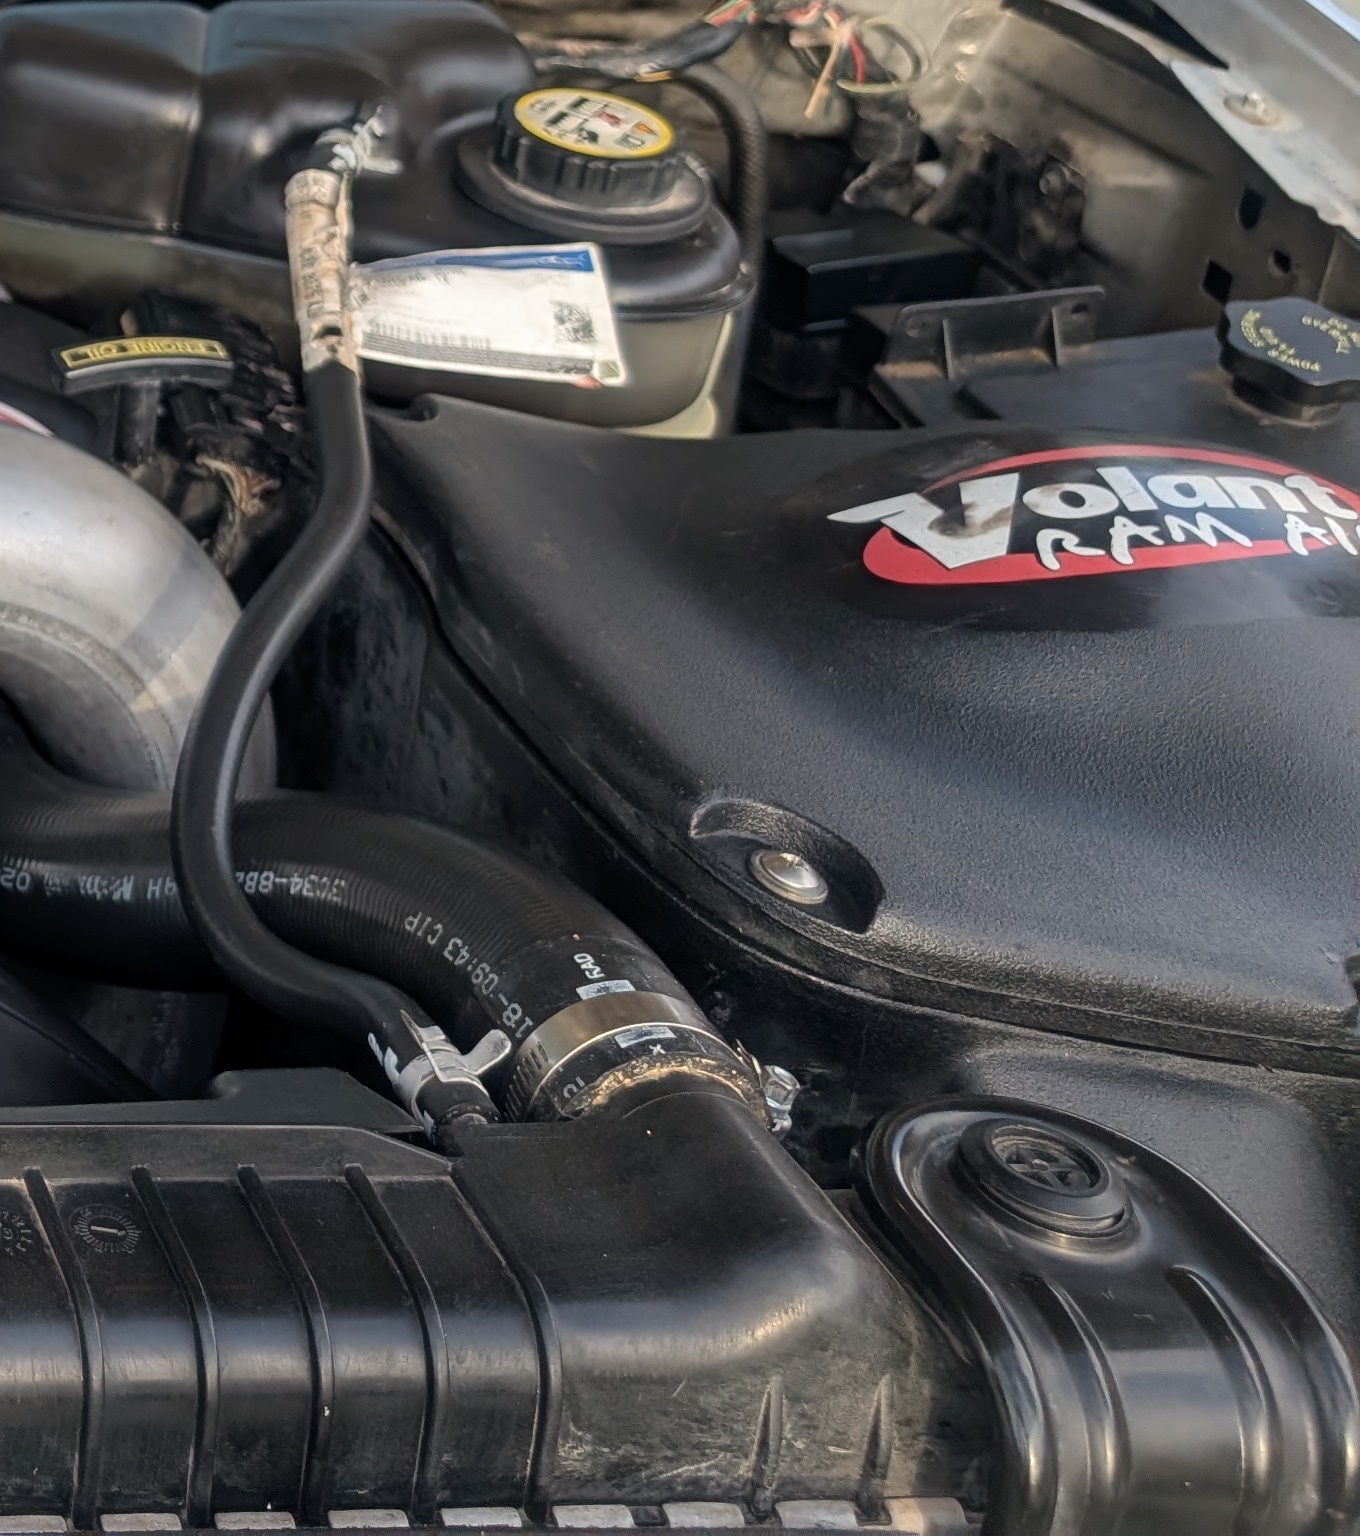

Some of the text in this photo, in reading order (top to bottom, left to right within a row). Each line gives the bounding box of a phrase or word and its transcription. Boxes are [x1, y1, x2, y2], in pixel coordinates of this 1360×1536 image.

[826, 466, 1359, 571] Volant
[1036, 512, 1360, 571] RAM AI
